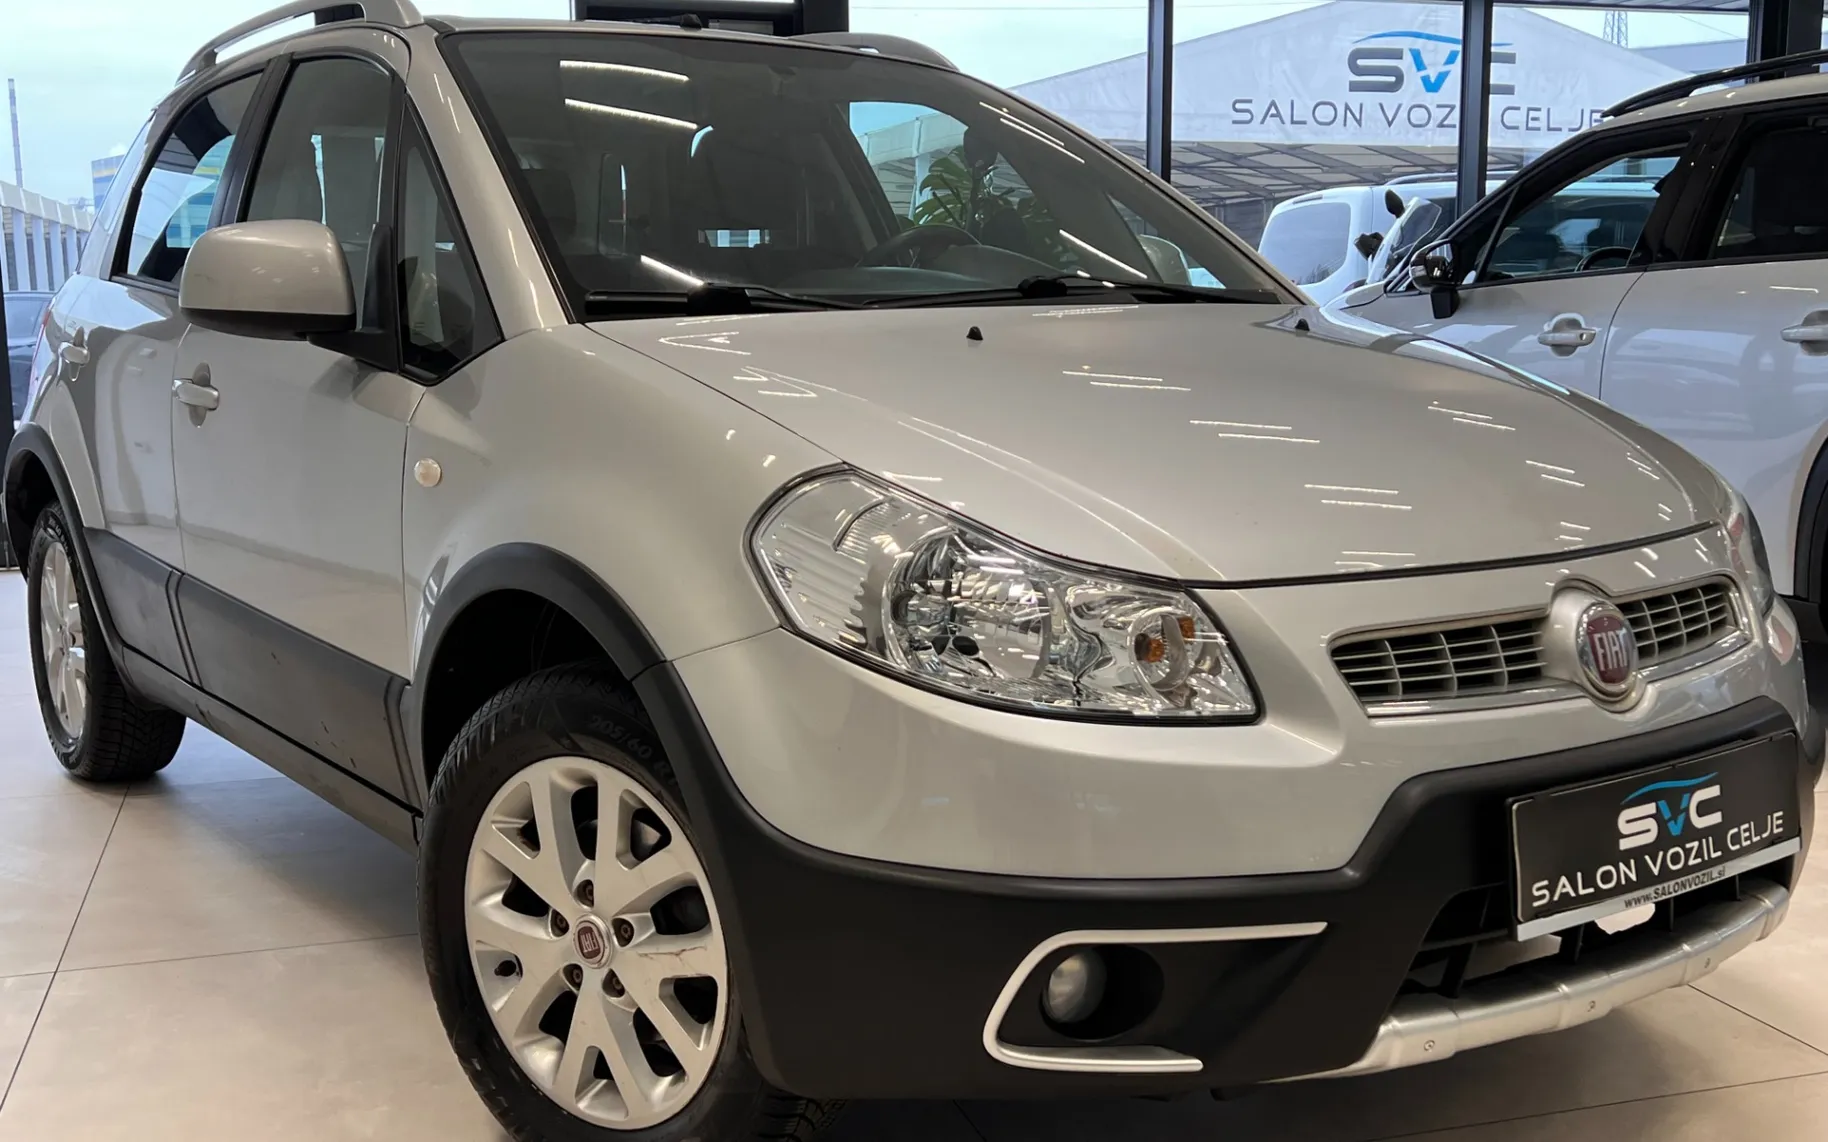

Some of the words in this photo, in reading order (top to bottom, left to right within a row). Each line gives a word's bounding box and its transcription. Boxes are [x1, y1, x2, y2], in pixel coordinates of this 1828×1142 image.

[1231, 98, 1363, 128] SALON
[1379, 102, 1457, 129] VOZ
[1592, 627, 1628, 672] FIAT
[1617, 784, 1723, 851] SVC
[1532, 858, 1638, 907] SALON
[1644, 836, 1723, 876] VOZIL
[1727, 810, 1784, 851] CELJE
[1624, 866, 1736, 908] www.SALONVOZIL.si
[580, 932, 600, 953] FIAT
